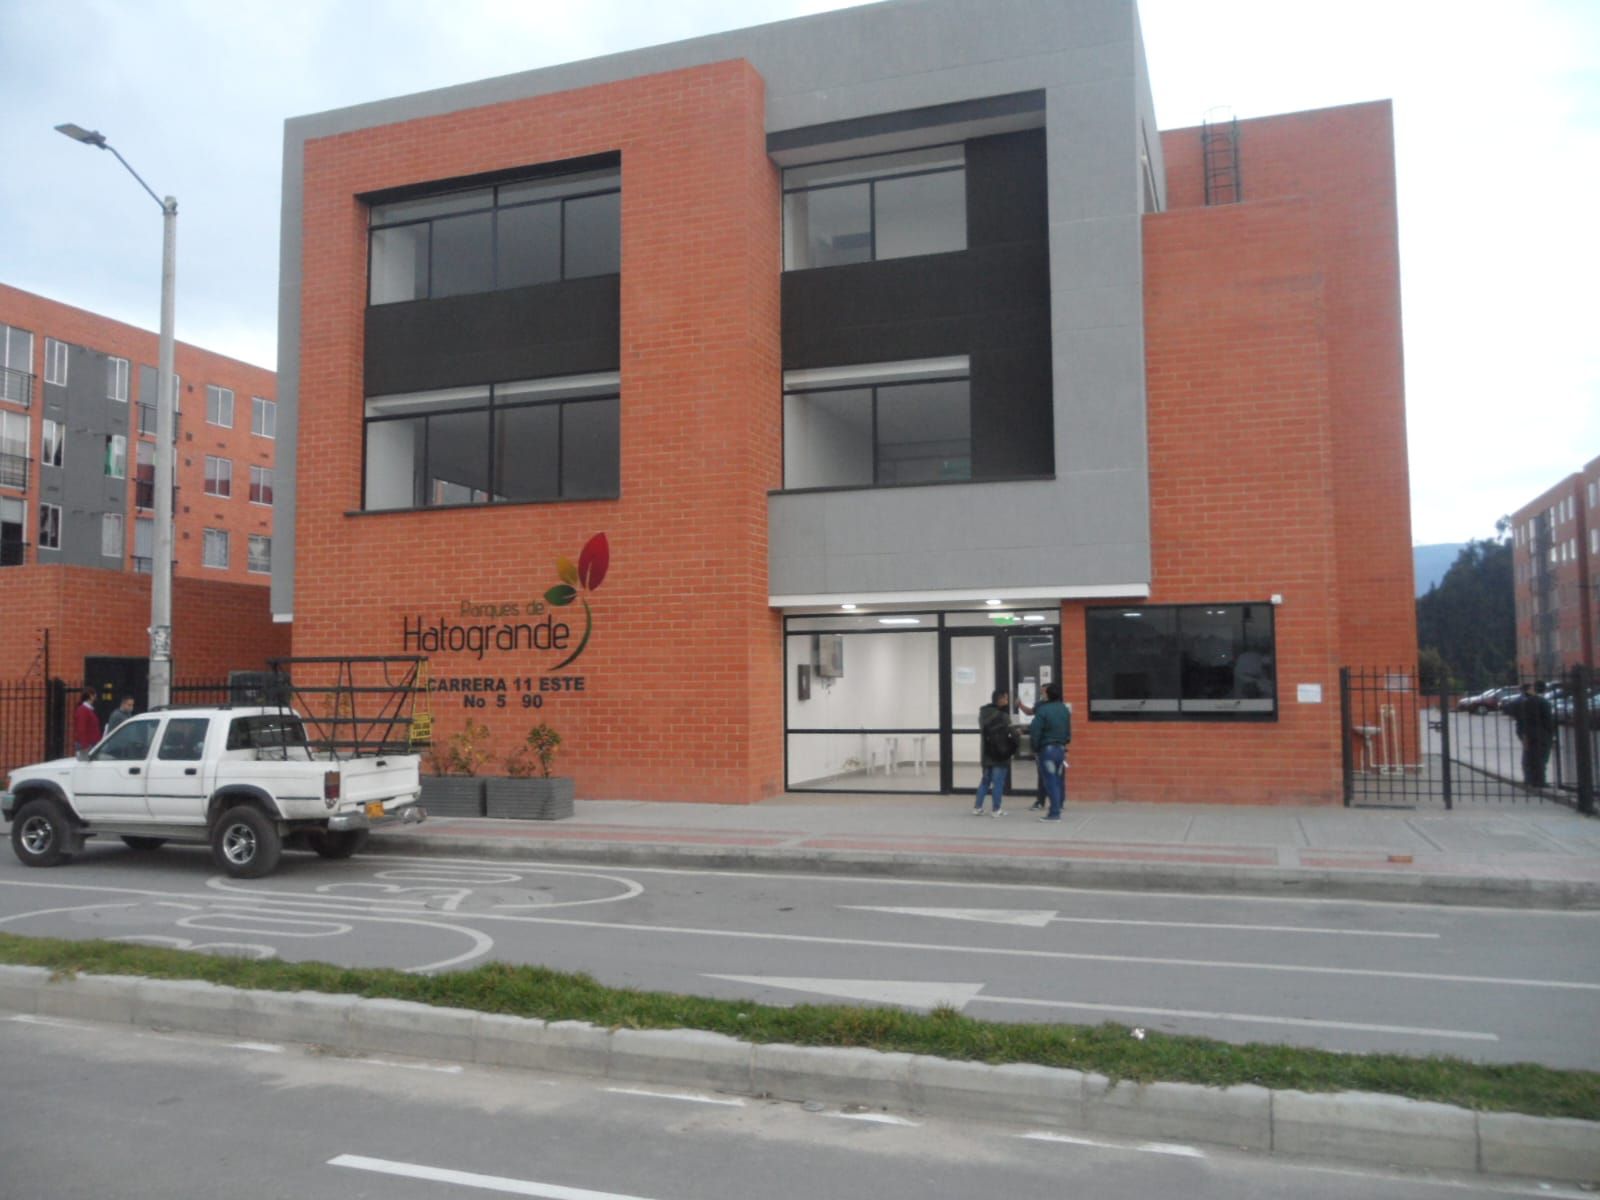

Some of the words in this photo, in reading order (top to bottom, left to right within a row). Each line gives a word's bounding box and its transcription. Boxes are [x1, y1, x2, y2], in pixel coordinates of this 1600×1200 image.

[460, 600, 520, 619] Parques
[526, 600, 545, 616] de
[403, 614, 570, 661] Hatogrande
[427, 677, 507, 692] CARRERA
[513, 677, 532, 691] 11
[539, 676, 585, 691] ESTE
[463, 695, 486, 708] No
[495, 695, 506, 708] 5
[521, 694, 544, 708] 90
